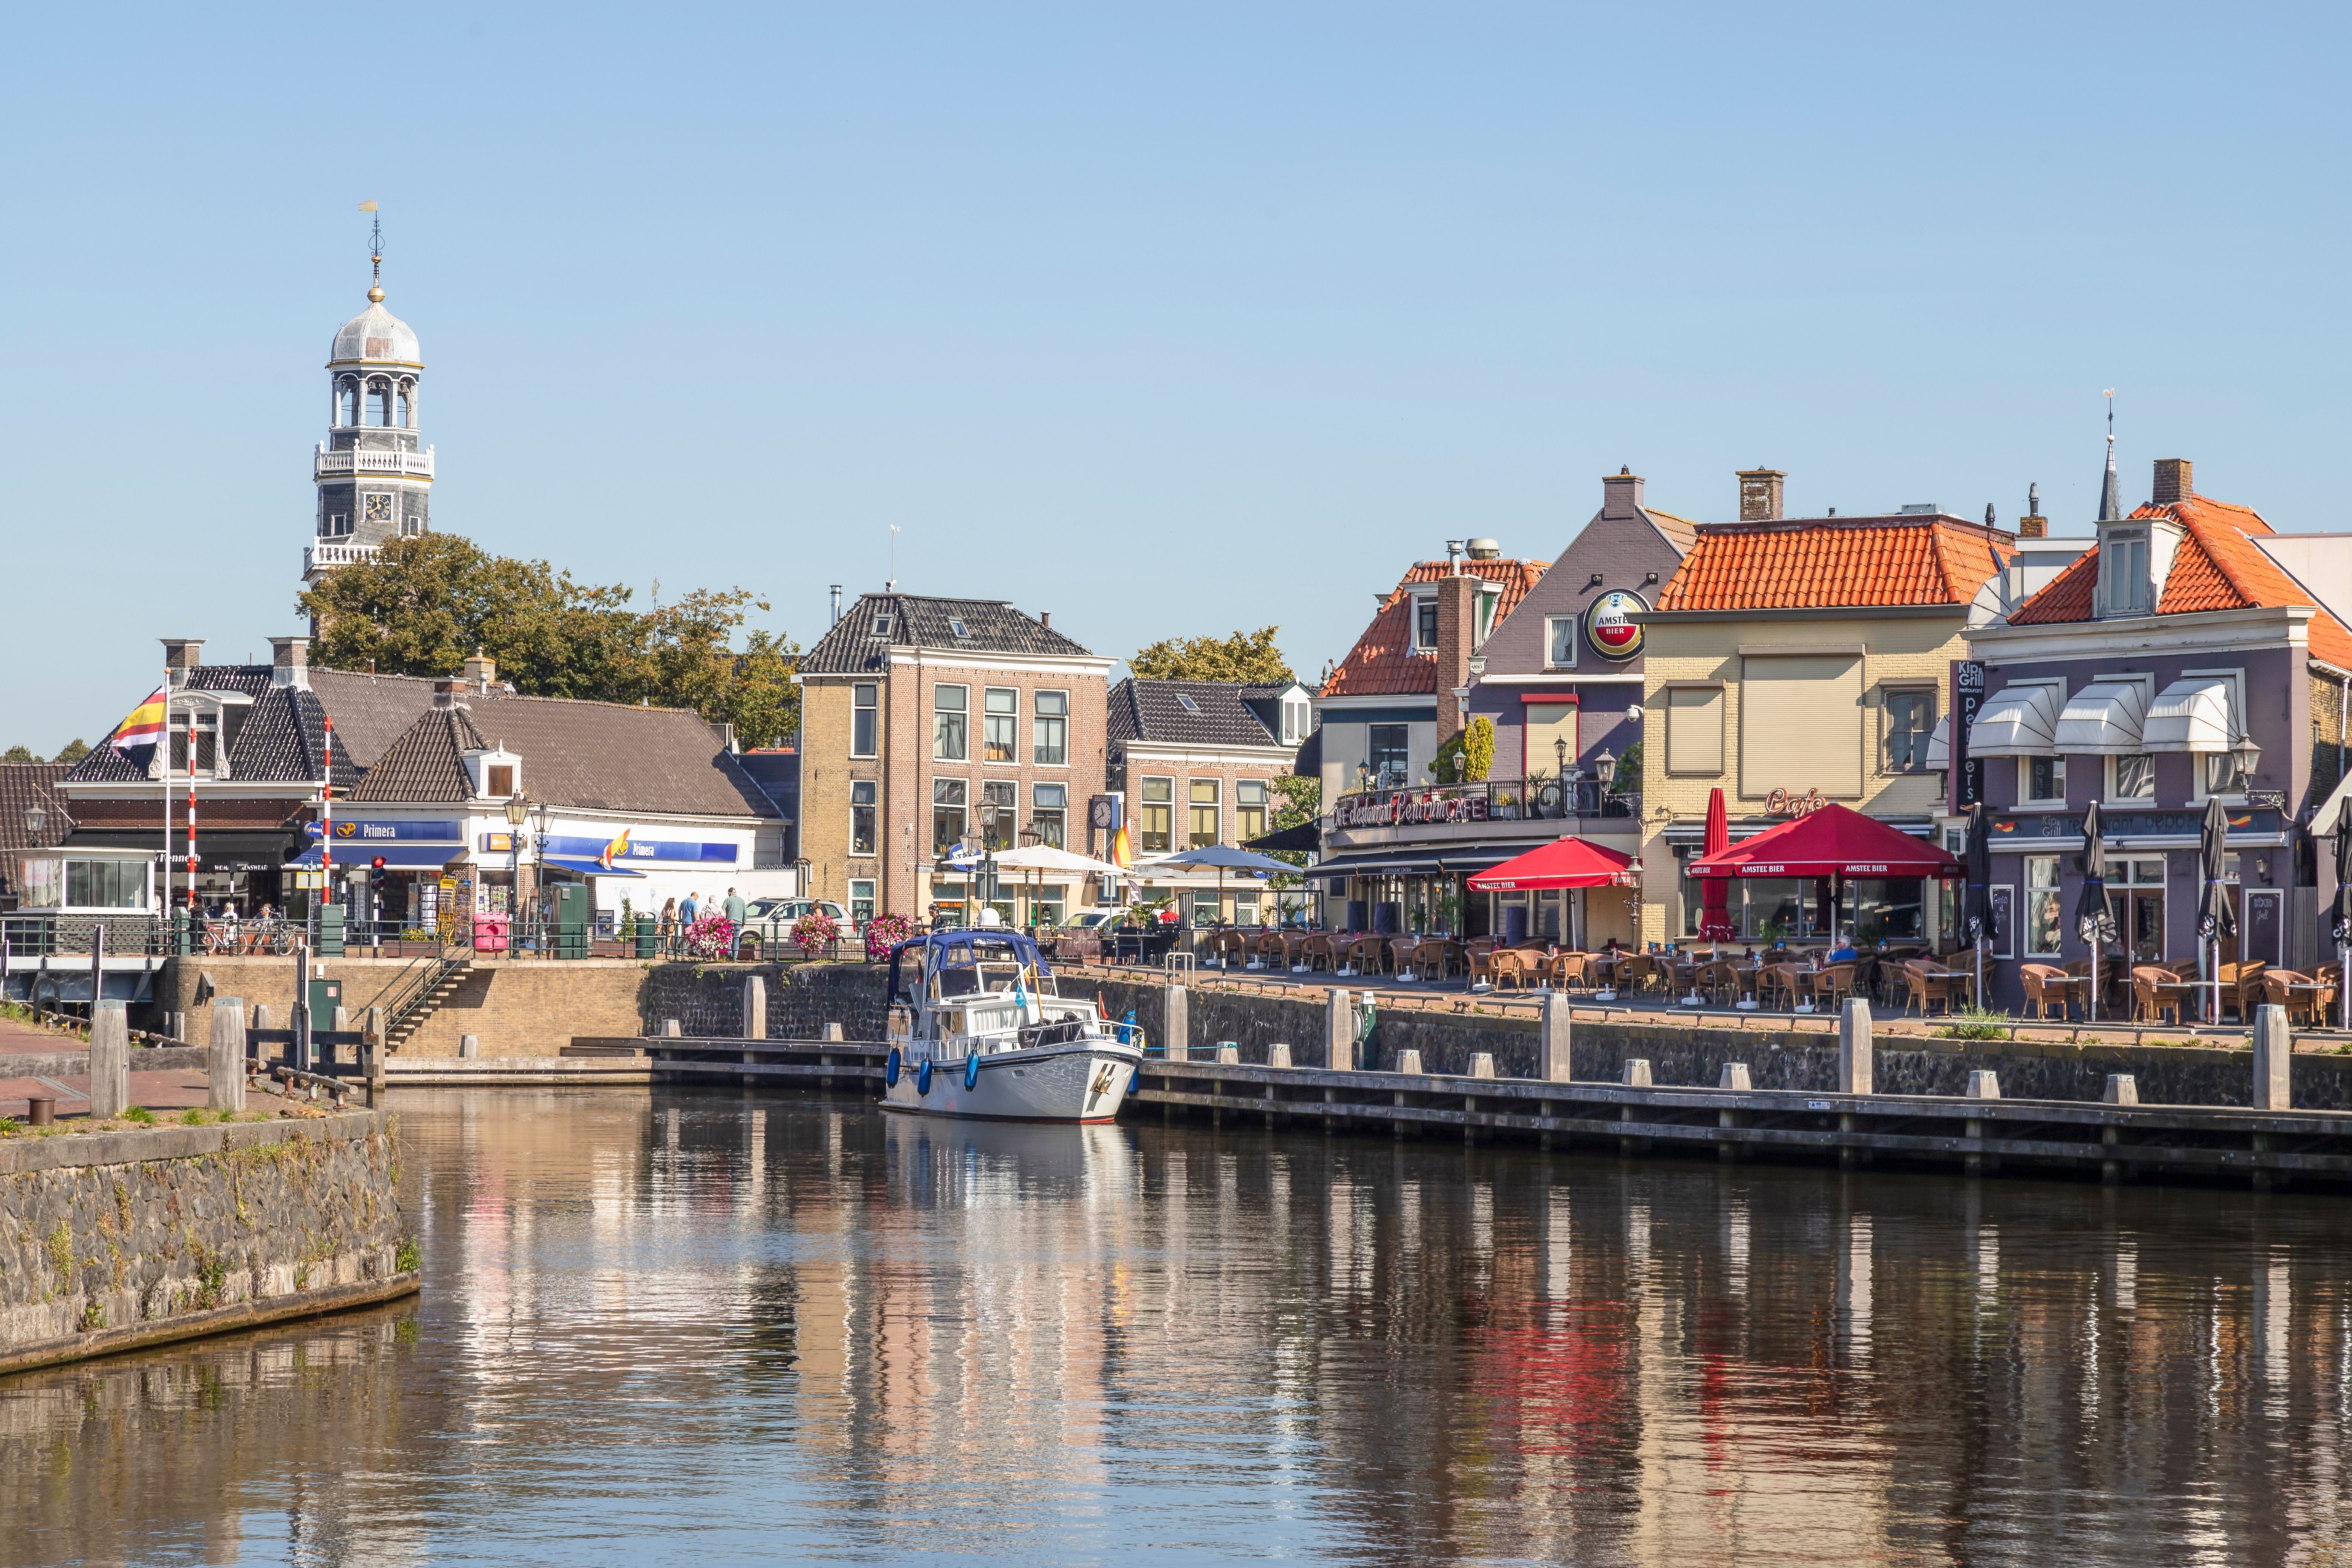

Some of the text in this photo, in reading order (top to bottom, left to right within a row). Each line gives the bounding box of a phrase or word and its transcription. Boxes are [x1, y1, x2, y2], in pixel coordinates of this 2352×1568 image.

[1599, 616, 1628, 625] AMSTE
[1959, 674, 1984, 686] Grill
[1349, 797, 1394, 824] Restaurant
[1396, 791, 1446, 821] Centrum
[1446, 797, 1485, 819] CAFE
[363, 824, 395, 838] Primera
[2043, 826, 2061, 836] Grill
[632, 842, 654, 857] Primera
[160, 853, 201, 862] Kenneh
